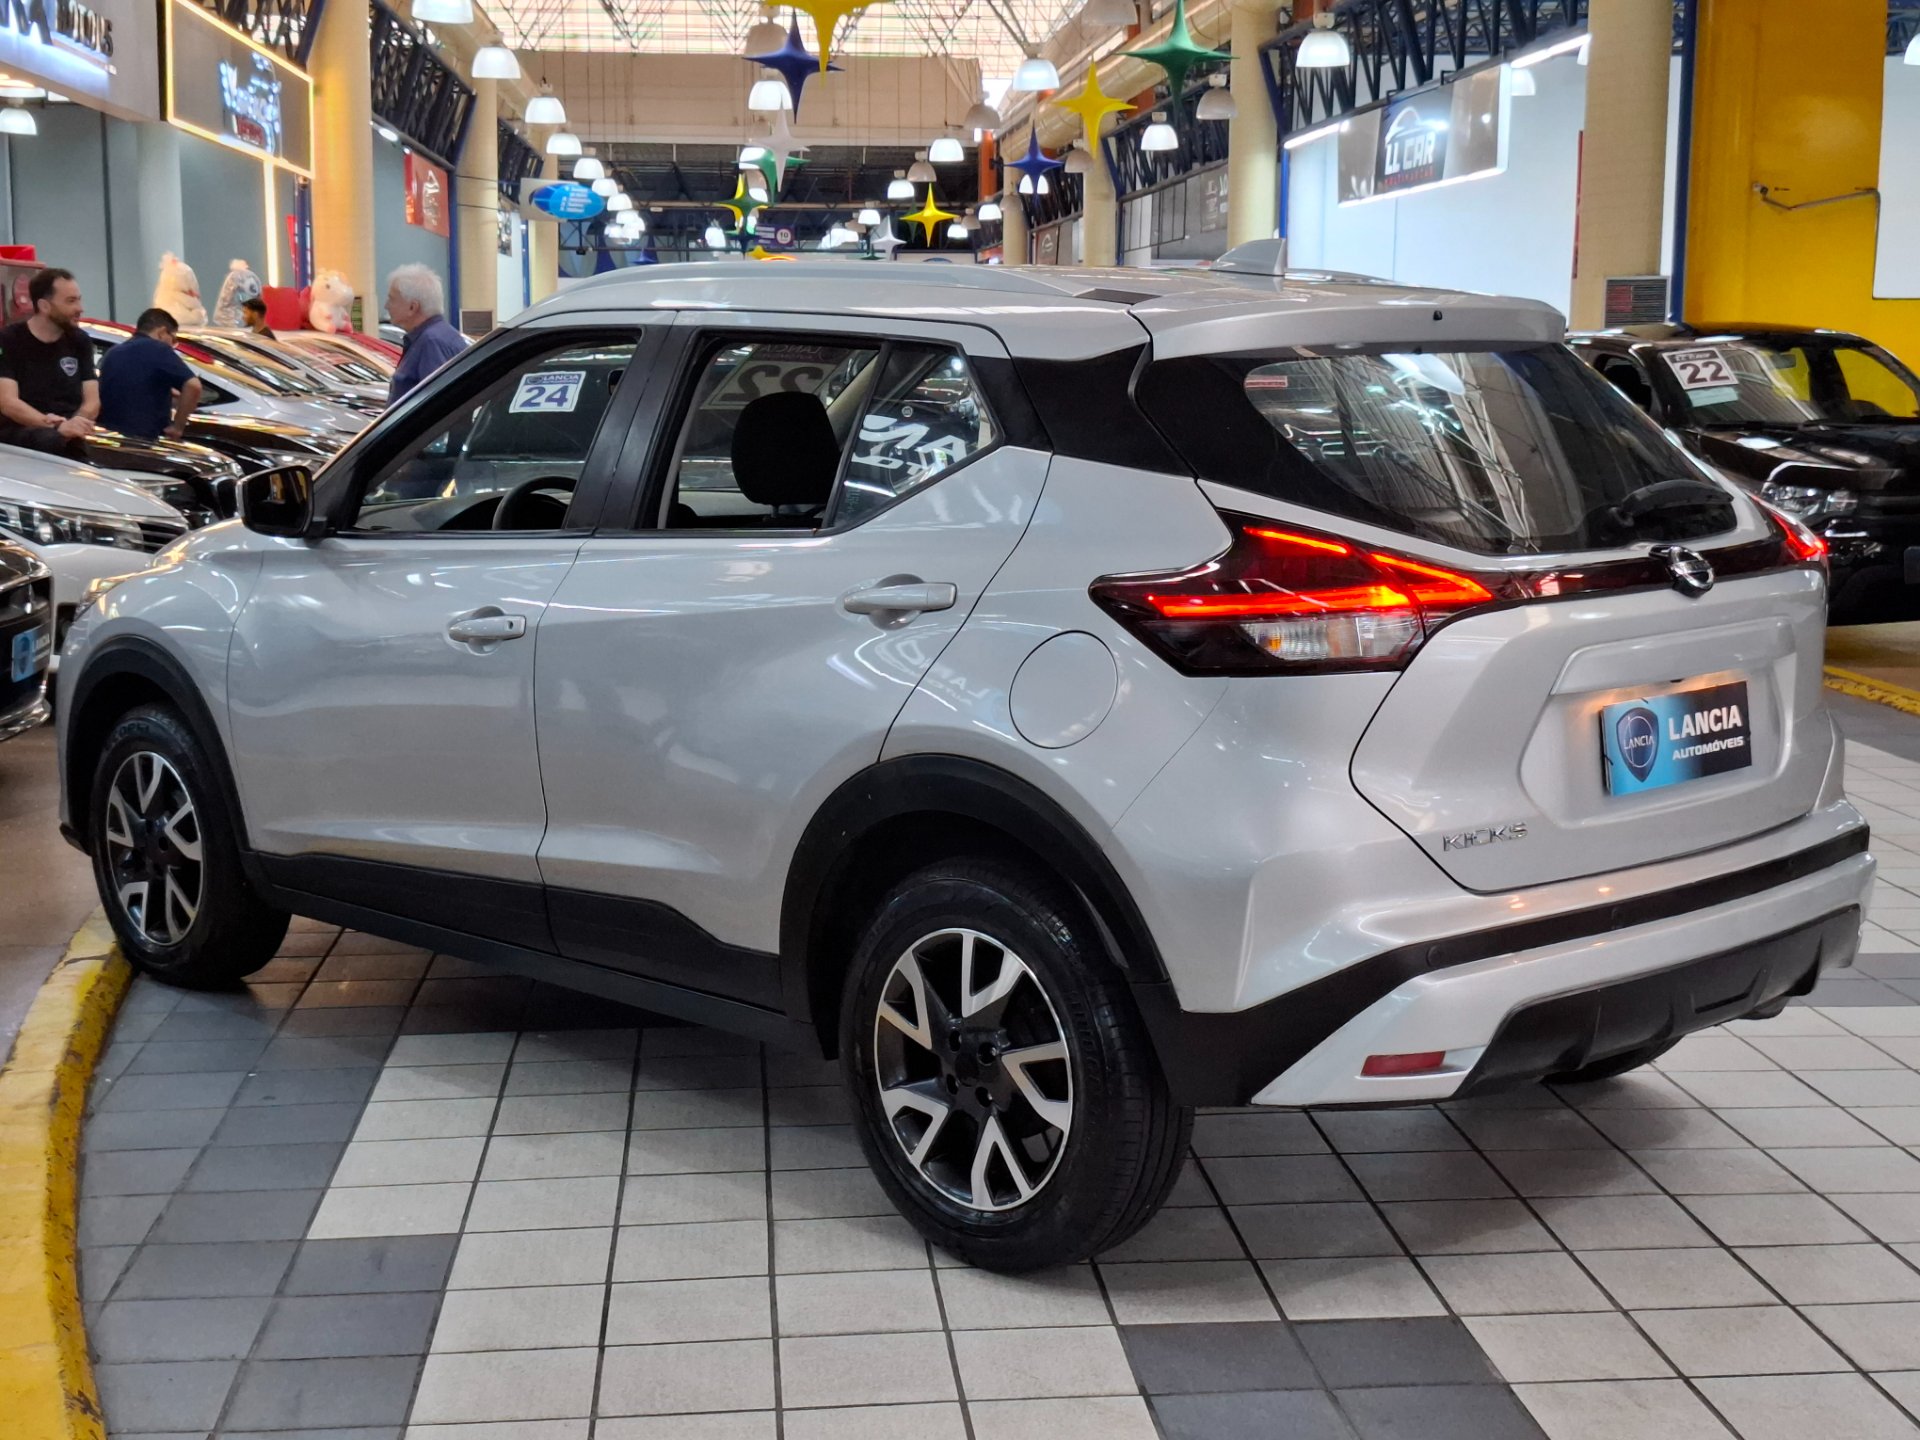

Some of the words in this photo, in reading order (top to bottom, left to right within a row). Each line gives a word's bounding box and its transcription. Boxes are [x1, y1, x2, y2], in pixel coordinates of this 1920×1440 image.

[1402, 130, 1436, 170] CAR
[1679, 360, 1730, 384] 22
[519, 385, 569, 408] 24
[1668, 704, 1743, 741] LANCIA
[1623, 735, 1655, 750] LANCIA
[1672, 736, 1744, 761] AUTOMÓVEIS
[1442, 822, 1528, 852] KICKS
